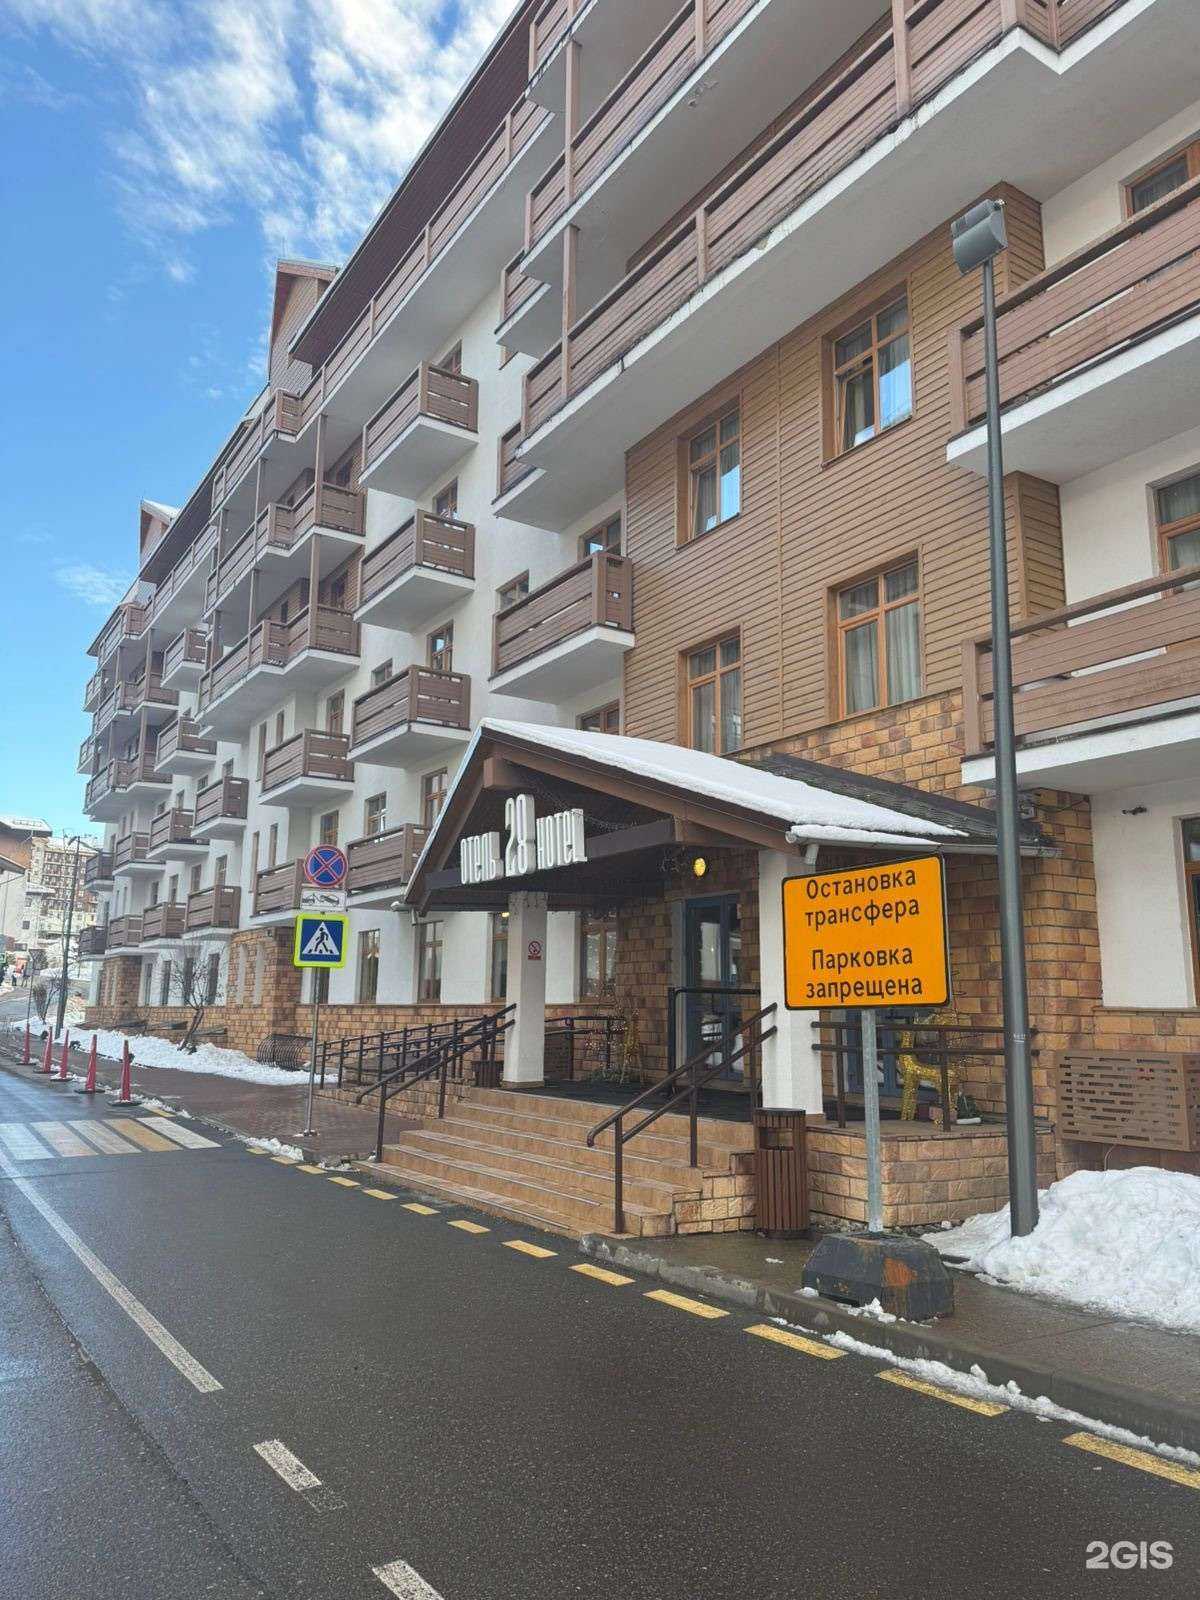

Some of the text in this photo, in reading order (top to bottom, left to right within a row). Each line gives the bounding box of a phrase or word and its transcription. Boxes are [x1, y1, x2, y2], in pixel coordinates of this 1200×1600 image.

[505, 794, 536, 877] 28
[806, 869, 916, 899] Остановка
[805, 899, 920, 931] трансфера
[812, 948, 913, 975] Парковка
[806, 977, 923, 1005] запрещена
